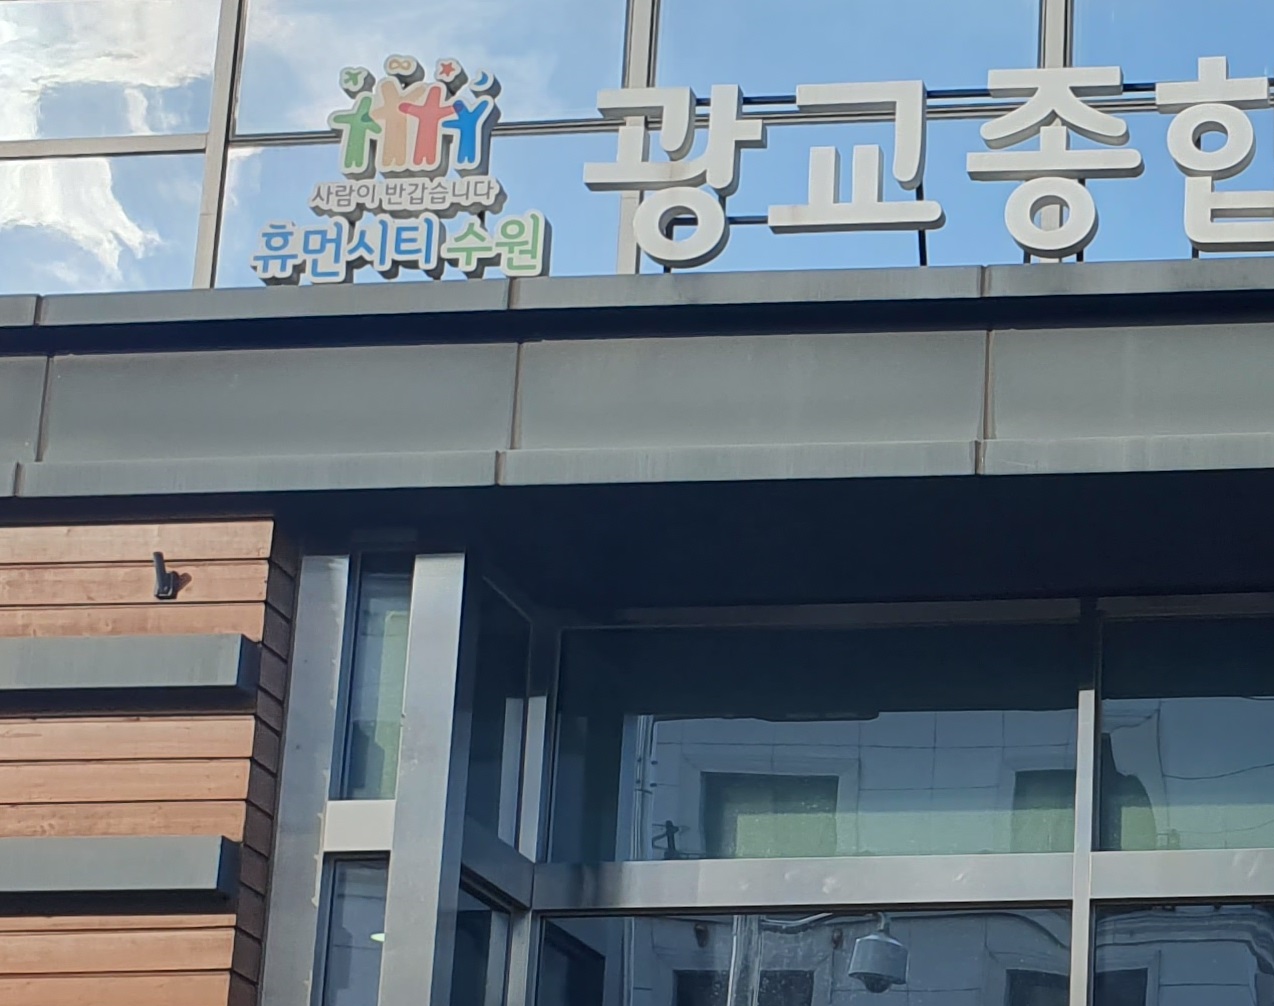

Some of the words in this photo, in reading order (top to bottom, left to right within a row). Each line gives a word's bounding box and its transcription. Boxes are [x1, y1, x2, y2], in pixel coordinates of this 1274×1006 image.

[312, 182, 377, 208] 사람이
[385, 179, 495, 206] 반갑습니다
[253, 217, 435, 278] 휴먼시티
[446, 212, 541, 271] 수원
